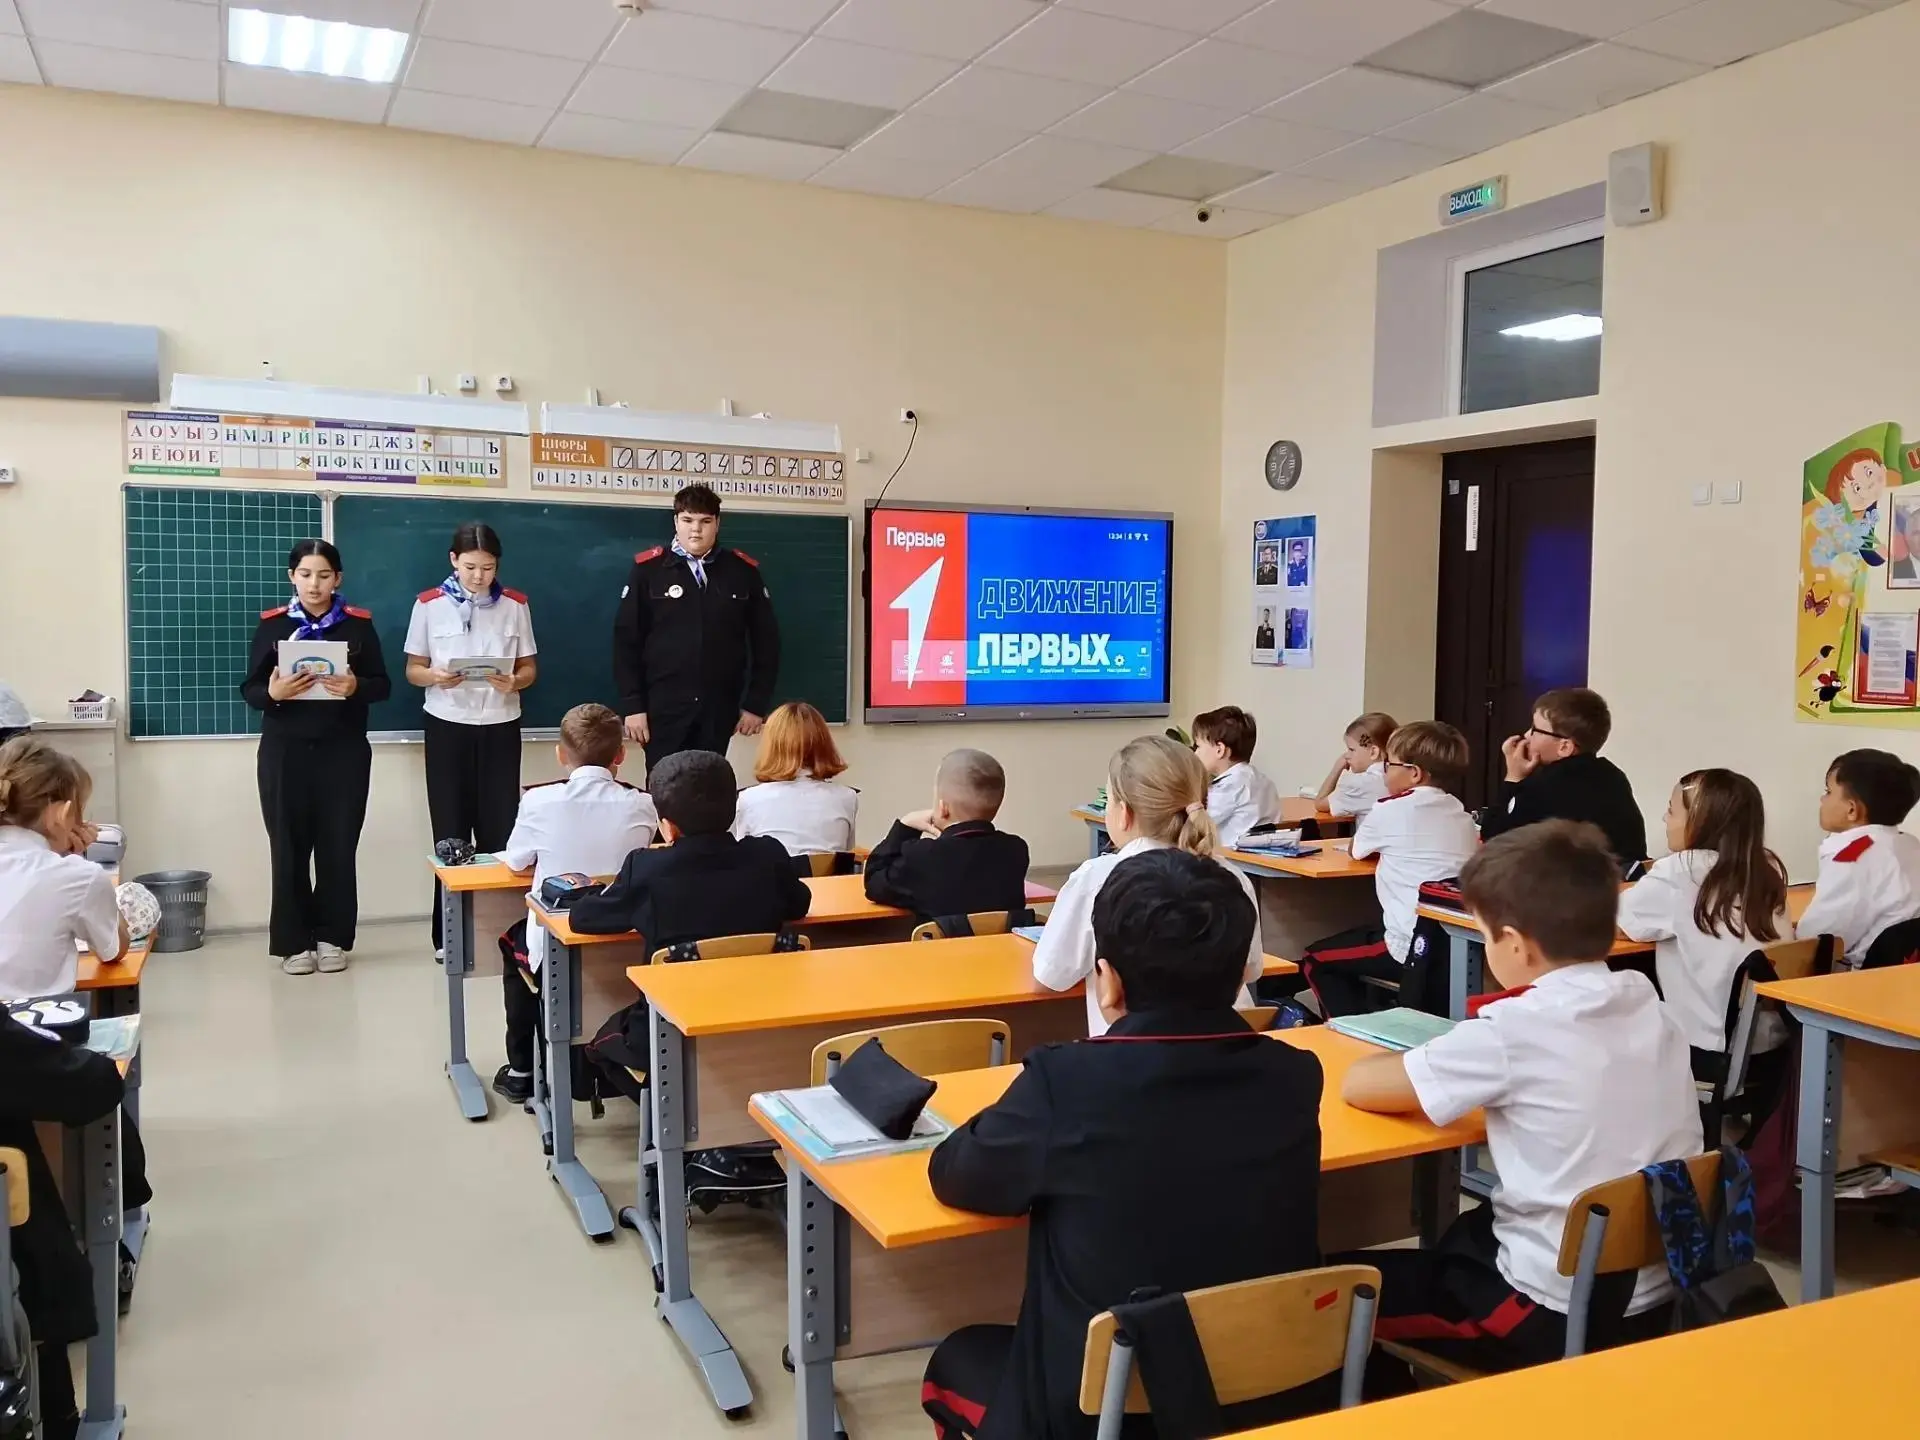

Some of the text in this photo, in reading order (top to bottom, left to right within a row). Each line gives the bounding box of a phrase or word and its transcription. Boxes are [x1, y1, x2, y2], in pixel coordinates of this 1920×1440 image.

[1450, 188, 1482, 211] ВЫХОД
[130, 425, 499, 454] А О У Ы Э Н М Л Р Й Б В Г Д Ж З Ъ
[541, 438, 587, 451] ЦИФРЫ
[132, 445, 499, 476] Я Ё Ю И Е П Ф К Т Ш С Х Ц Ч Щ Ь
[541, 451, 596, 464] И ЧИСЛА
[617, 448, 843, 480] 0 1 2 3 4 5 6 7 8 9
[537, 471, 544, 482] 0
[570, 473, 576, 484] 2
[586, 474, 592, 485] 3
[601, 475, 607, 485] 4
[617, 475, 624, 486] 5
[632, 476, 639, 487] 6
[648, 477, 654, 488] 7
[662, 478, 669, 488] 8
[677, 479, 684, 489] 9
[720, 481, 730, 492] 12
[734, 482, 745, 492] 13
[748, 483, 759, 493] 14
[762, 484, 773, 494] 15
[776, 485, 787, 495] 16
[790, 485, 800, 496] 17
[804, 486, 815, 496] 18
[818, 486, 829, 497] 19
[831, 487, 842, 497] 20
[886, 526, 946, 552] Первые
[978, 578, 1157, 619] ДВИЖЕНИЕ
[978, 633, 1110, 667] ПЕРВЫХ
